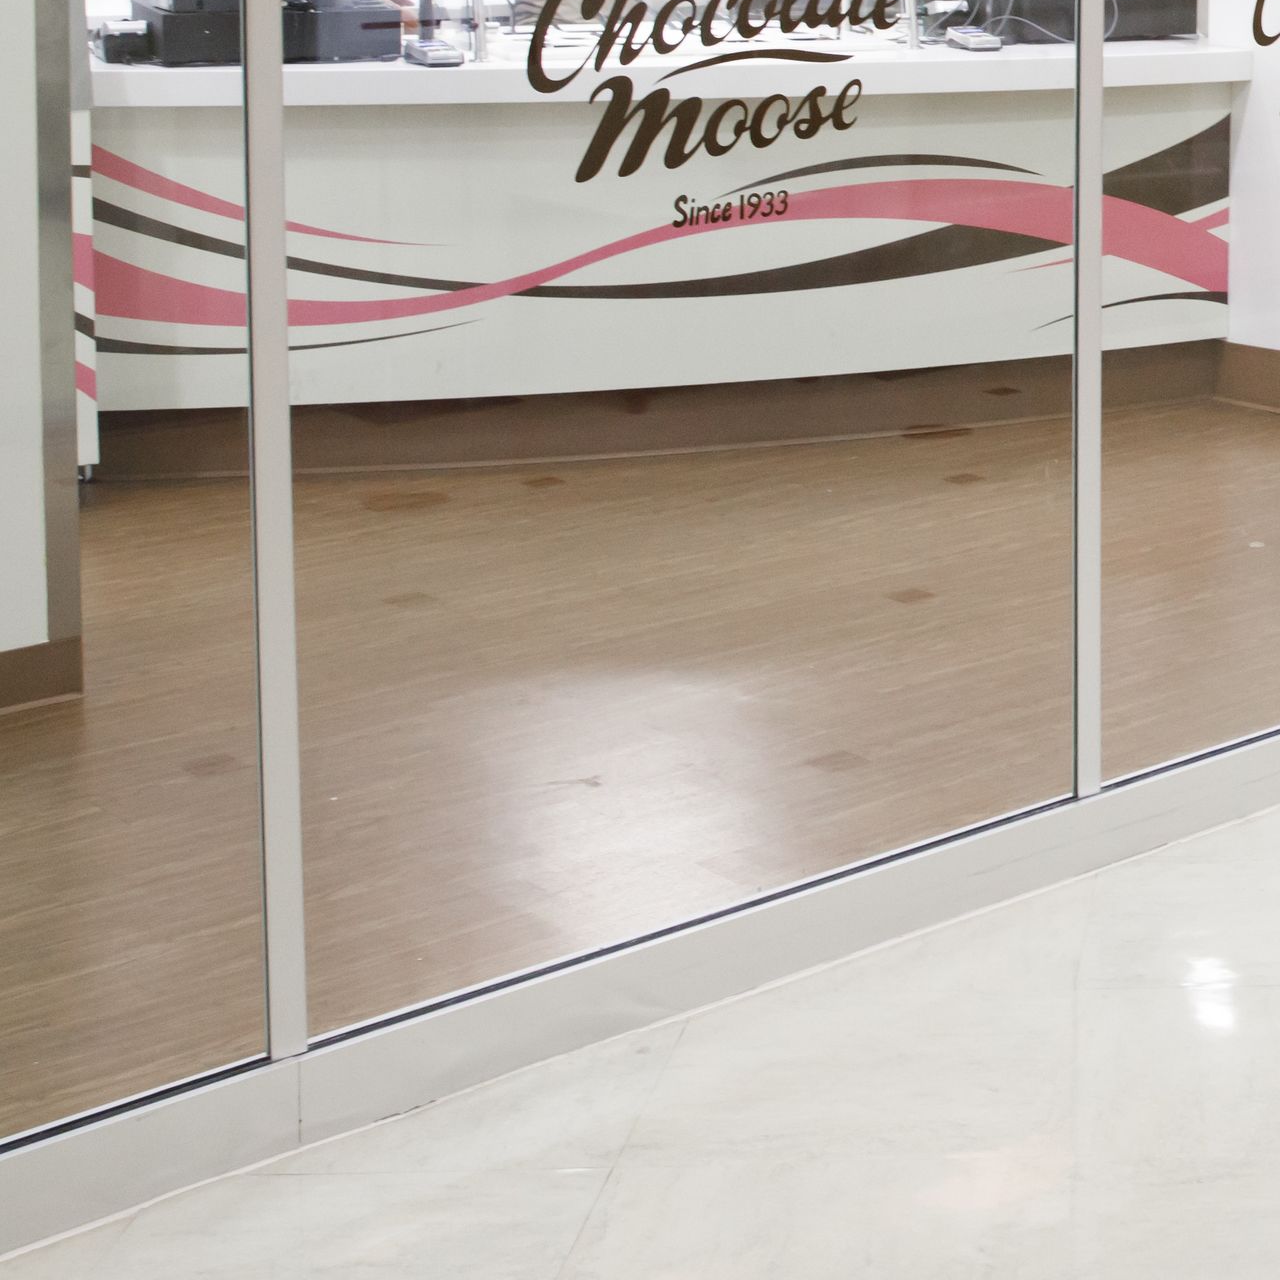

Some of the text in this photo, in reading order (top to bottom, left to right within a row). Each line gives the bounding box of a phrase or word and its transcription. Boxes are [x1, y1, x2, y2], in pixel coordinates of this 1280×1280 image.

[576, 76, 862, 182] Moose
[672, 190, 789, 228] Since 1933
